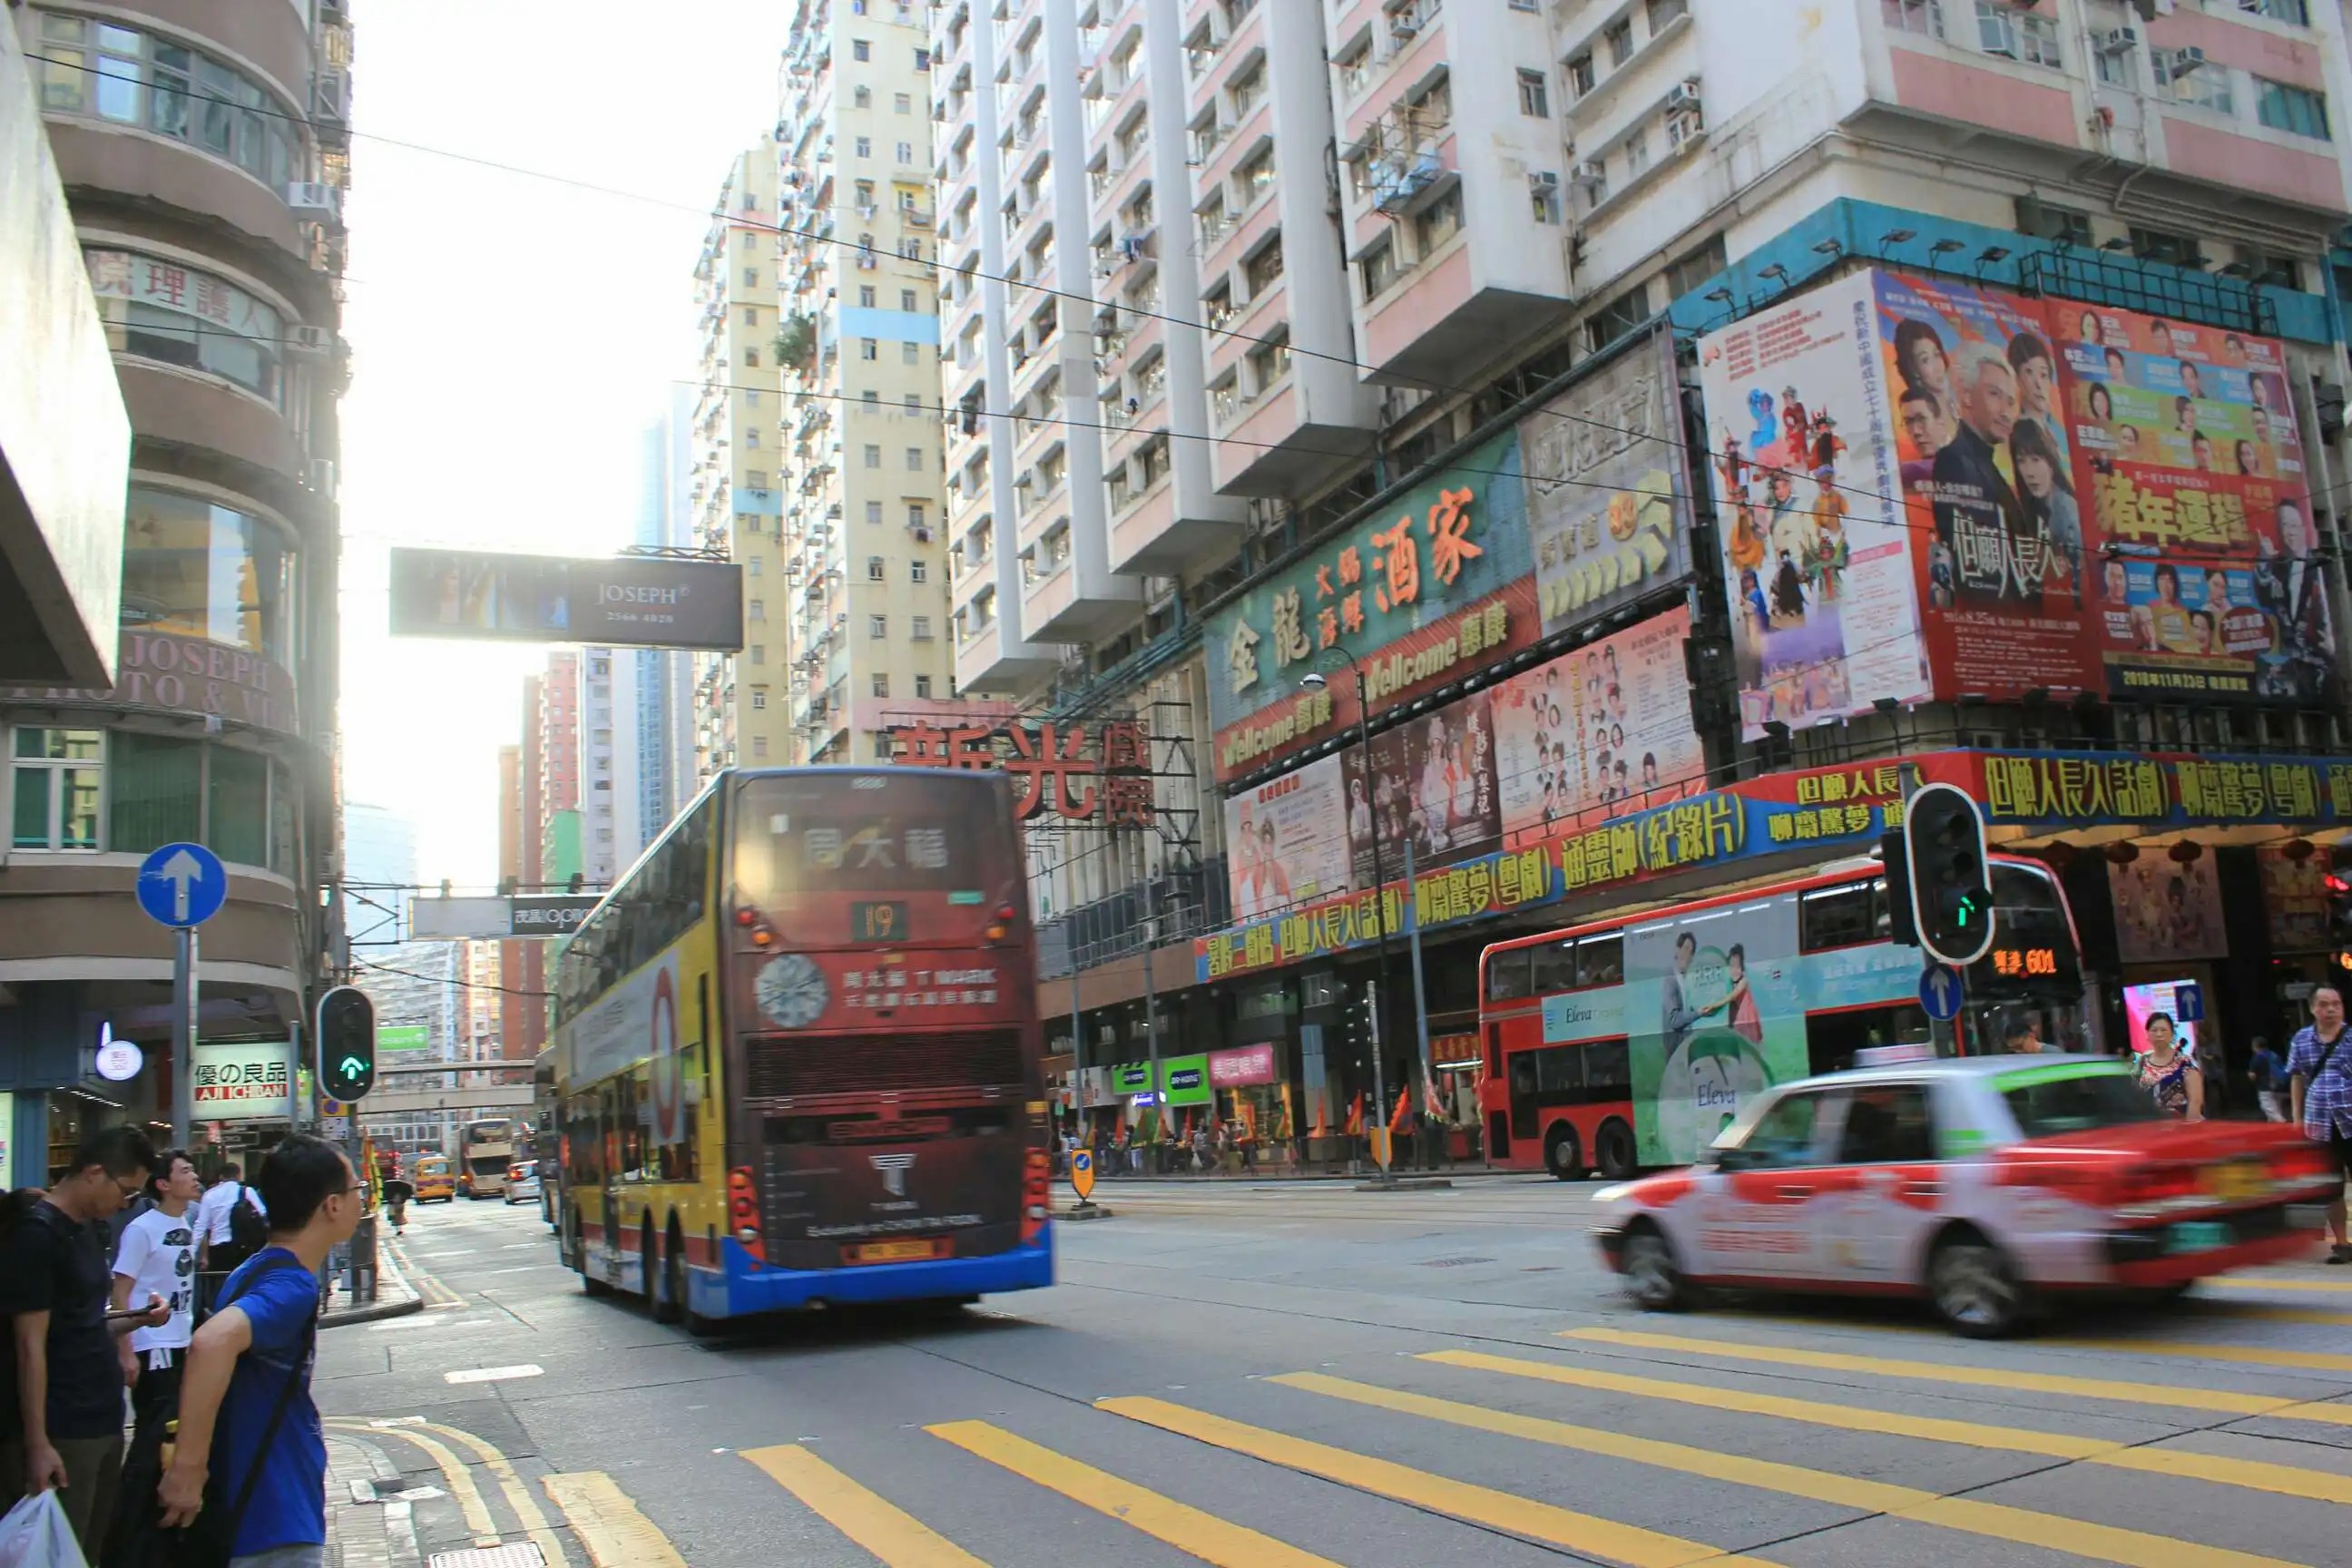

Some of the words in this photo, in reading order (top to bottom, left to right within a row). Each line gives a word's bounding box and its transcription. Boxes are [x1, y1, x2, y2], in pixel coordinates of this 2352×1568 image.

[2092, 469, 2253, 547] 豬年運程
[1953, 503, 2064, 599] 但願人長久
[1230, 586, 1311, 694] 金龍
[1371, 486, 1483, 613] 酒家
[124, 635, 269, 691] JOSEPH
[1365, 637, 1456, 703] Wellcome
[1460, 600, 1507, 658] 惠康
[1224, 715, 1294, 769] Wellcome
[1562, 790, 1745, 891] 通靈師(紀錄片)
[2025, 948, 2058, 974] 601
[1565, 1005, 1592, 1024] Eleva
[195, 1061, 288, 1086] 優の良品
[200, 1086, 224, 1100] AJI
[229, 1084, 285, 1100] ICHIBAN
[1697, 1083, 1735, 1108] Eleva
